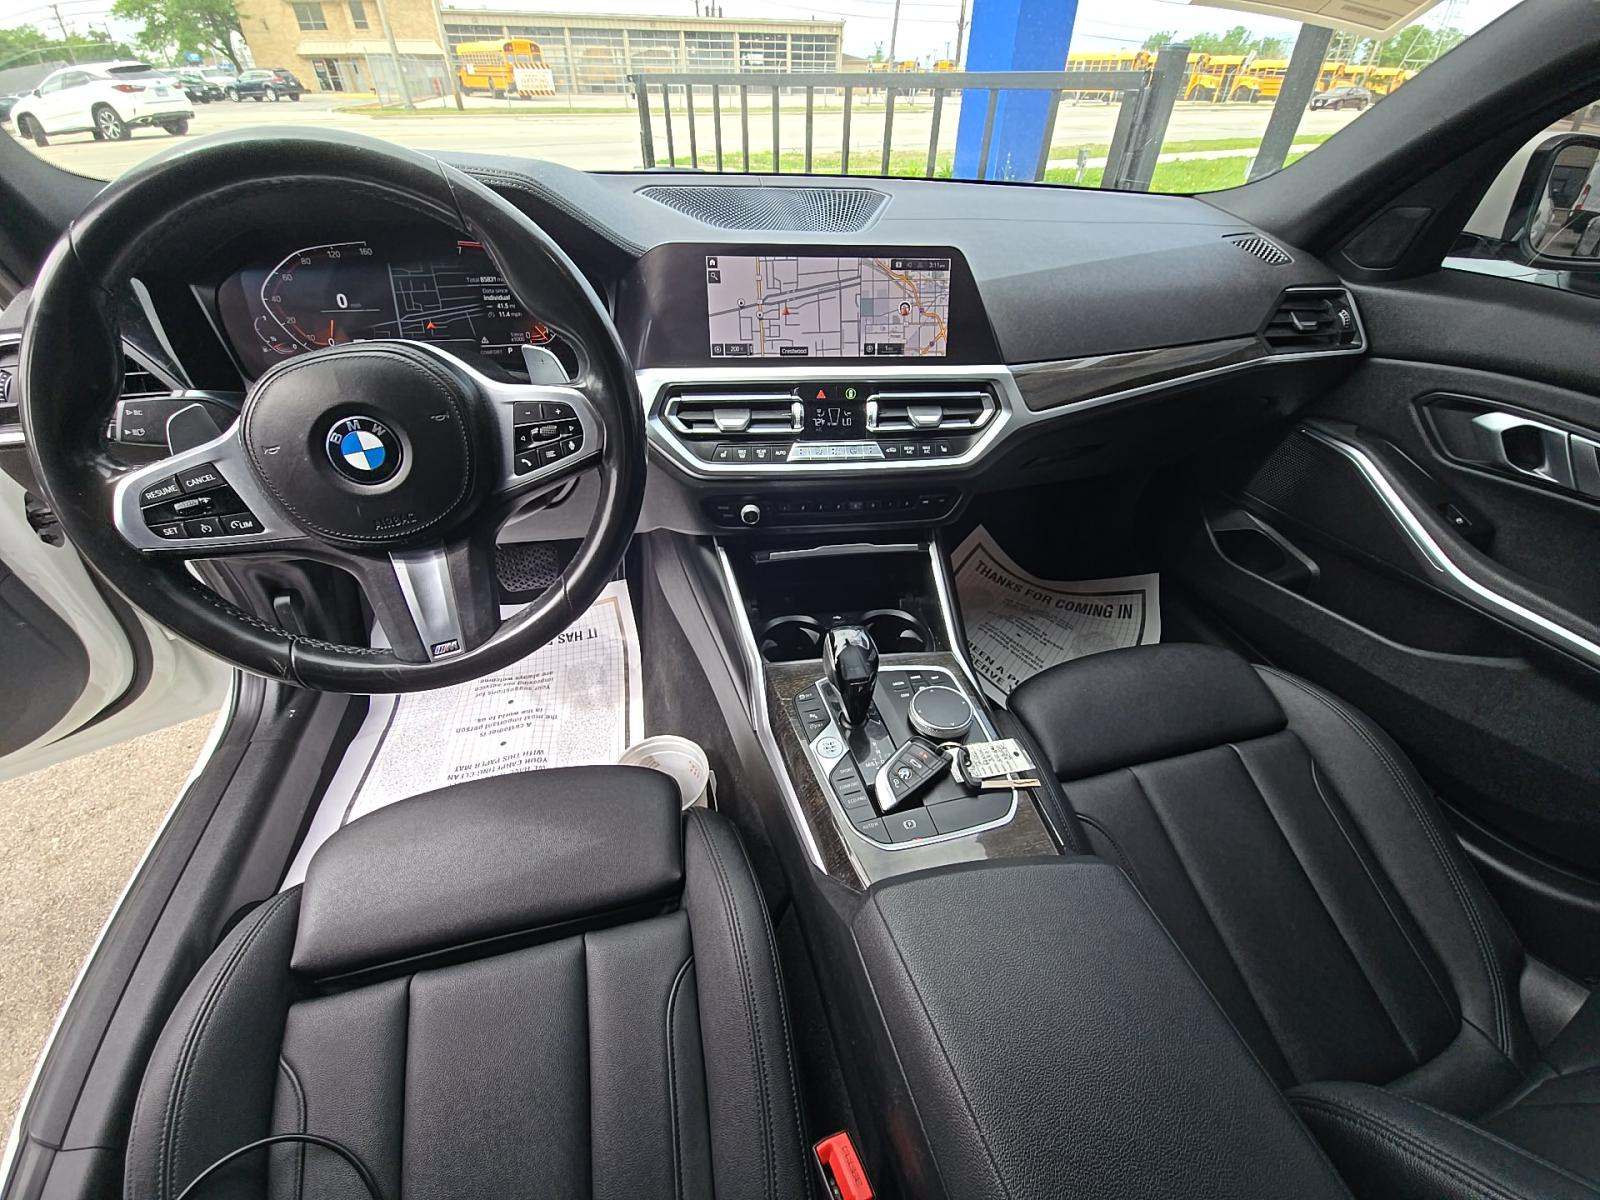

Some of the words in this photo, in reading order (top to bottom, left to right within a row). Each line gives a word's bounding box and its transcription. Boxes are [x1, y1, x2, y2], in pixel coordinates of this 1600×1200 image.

[336, 294, 348, 308] 0
[330, 420, 386, 444] BMW
[186, 474, 216, 487] CANCEL
[145, 484, 178, 500] RESUME
[163, 526, 178, 536] SET
[975, 560, 1023, 592] THANKS
[1024, 588, 1052, 605] FOR
[1056, 600, 1114, 618] COMING
[1118, 604, 1133, 619] IN
[558, 630, 582, 644] HAS
[587, 628, 598, 640] IT
[996, 666, 1004, 674] A
